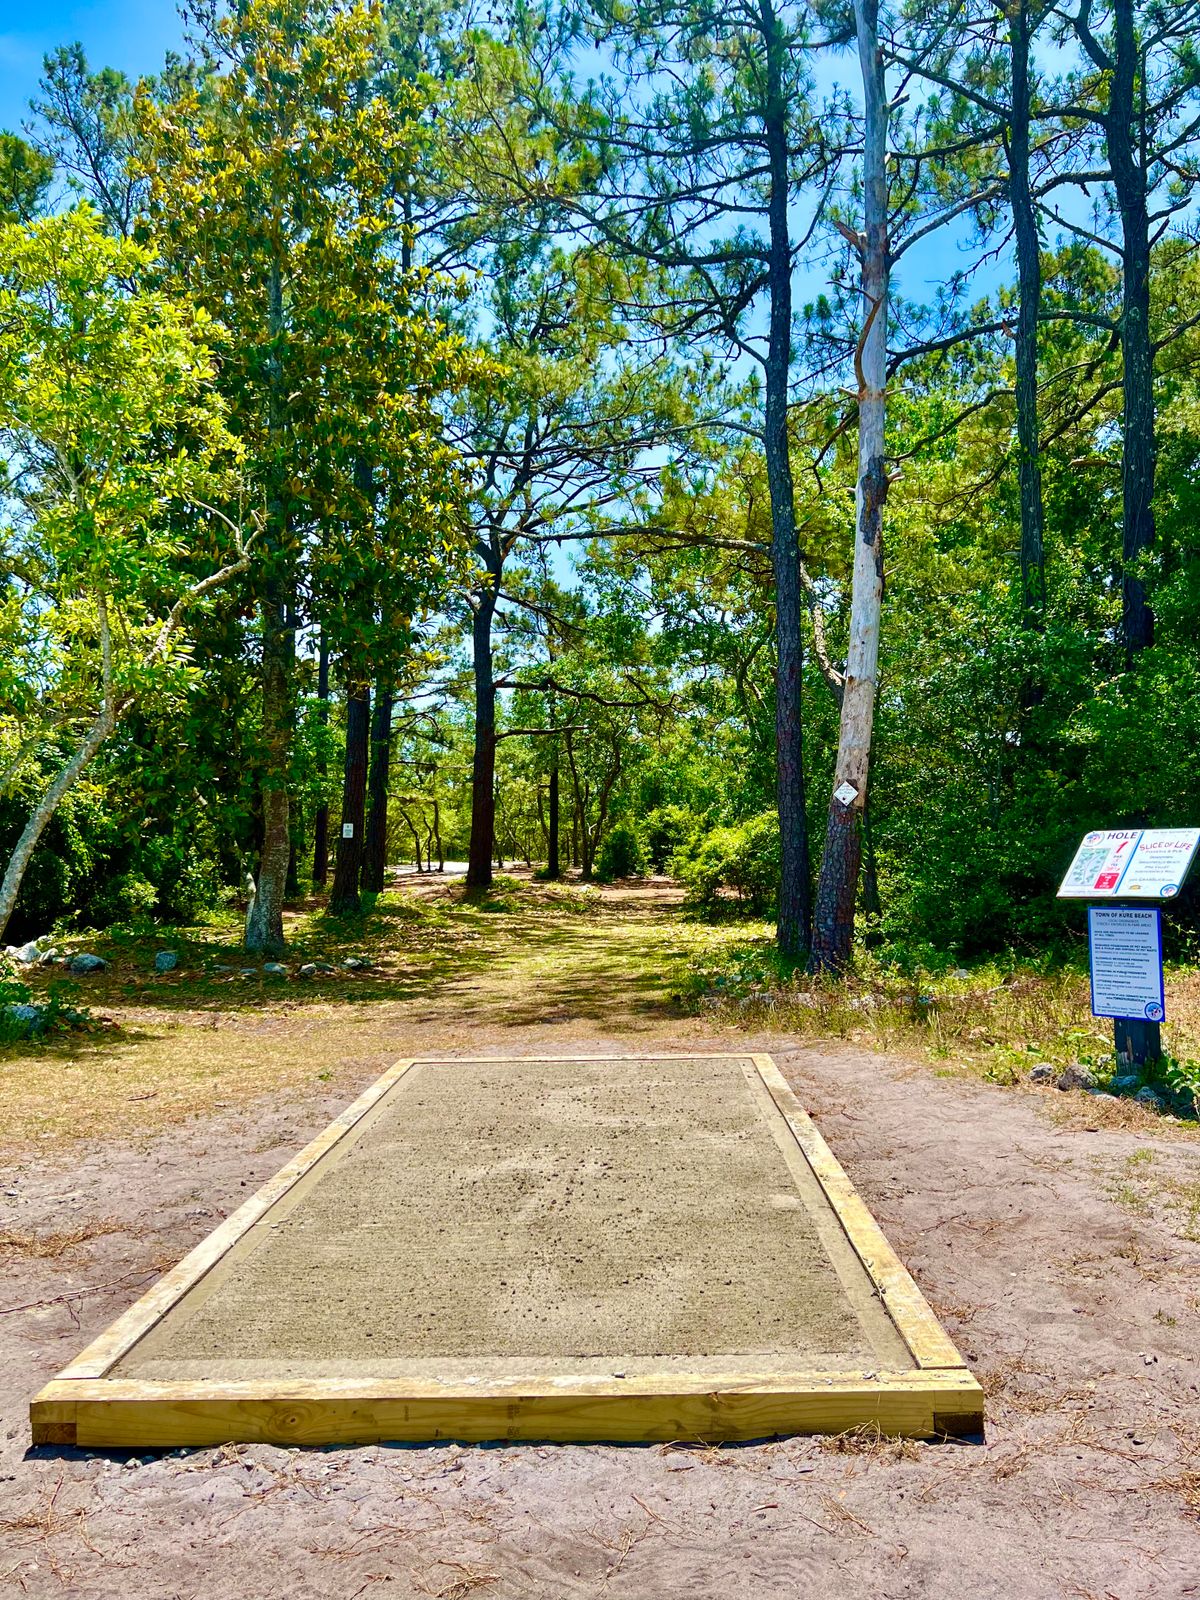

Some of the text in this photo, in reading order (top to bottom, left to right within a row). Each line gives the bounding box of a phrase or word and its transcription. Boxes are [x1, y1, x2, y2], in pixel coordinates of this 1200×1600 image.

[1107, 832, 1138, 840] HOLE
[1140, 841, 1164, 851] SLICE
[1174, 840, 1193, 851] LIFE
